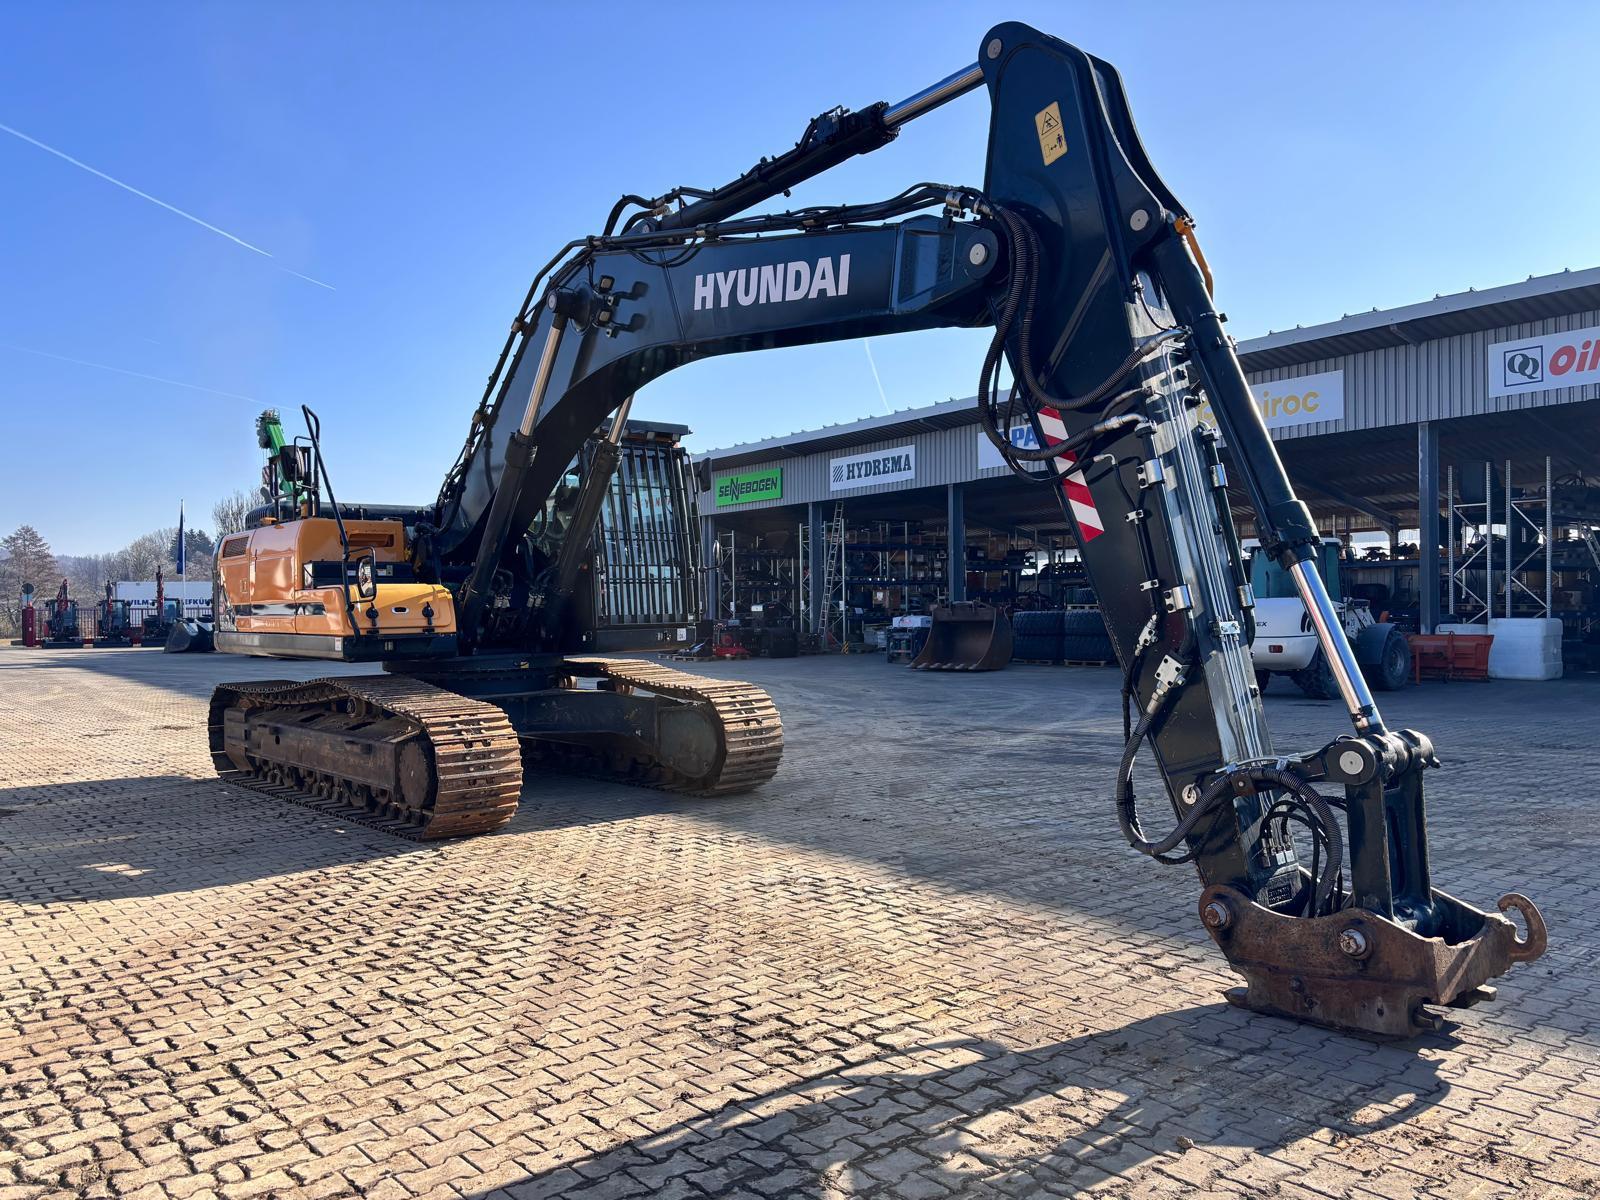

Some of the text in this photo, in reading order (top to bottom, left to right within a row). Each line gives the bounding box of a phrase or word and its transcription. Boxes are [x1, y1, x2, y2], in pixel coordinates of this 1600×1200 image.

[693, 254, 850, 311] HYUNDAI
[847, 454, 912, 480] HYDREMA
[719, 477, 778, 502] SENNEBOGEN
